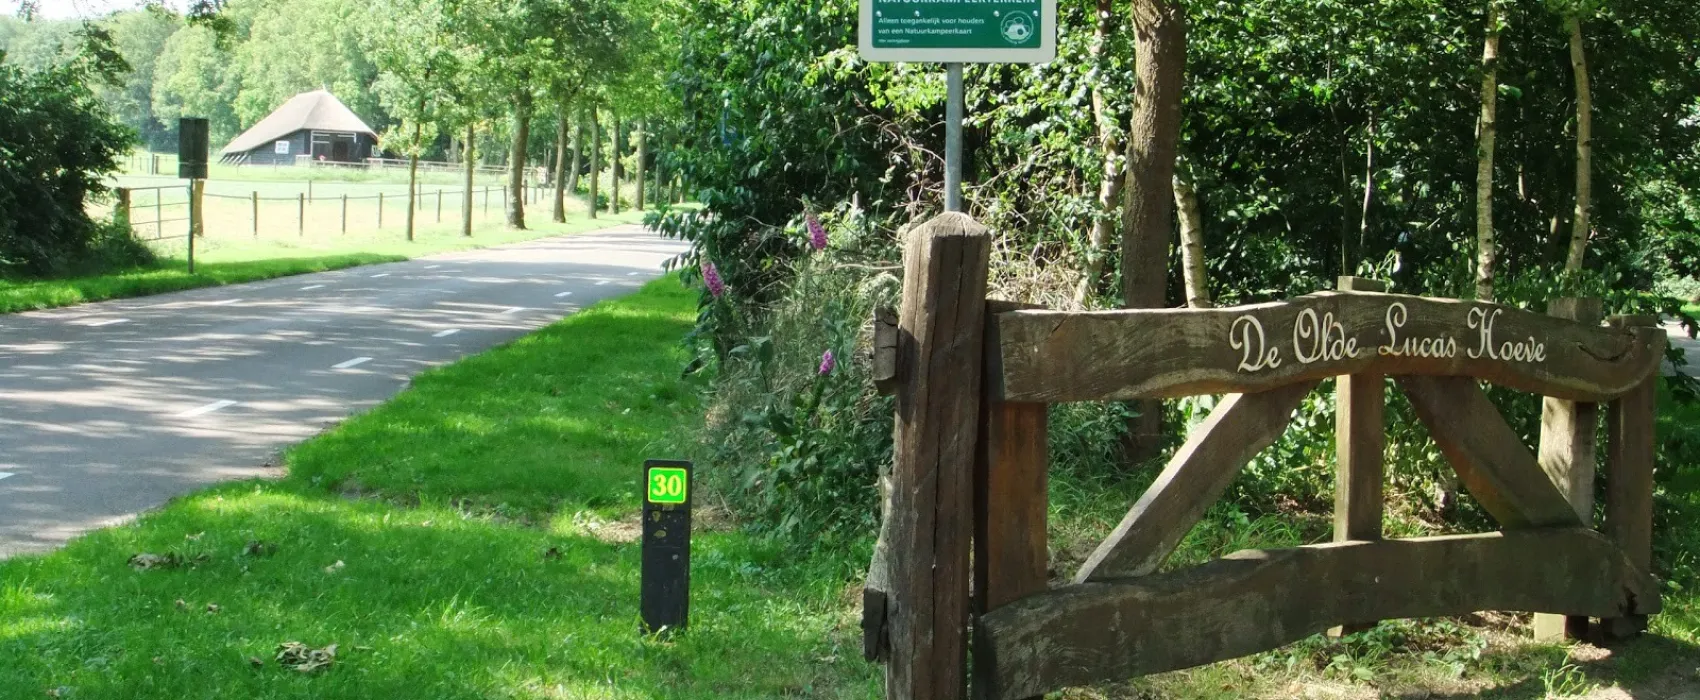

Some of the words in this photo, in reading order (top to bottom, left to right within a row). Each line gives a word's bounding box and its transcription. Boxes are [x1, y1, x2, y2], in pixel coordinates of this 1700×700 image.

[900, 17, 940, 25] toegankelijk
[904, 27, 973, 35] Natuurkampeerkaart
[1229, 314, 1282, 373] De
[1293, 307, 1360, 364] Olde
[1378, 302, 1457, 358] Lucas
[1466, 307, 1547, 362] Hoeve
[652, 474, 682, 496] 30
